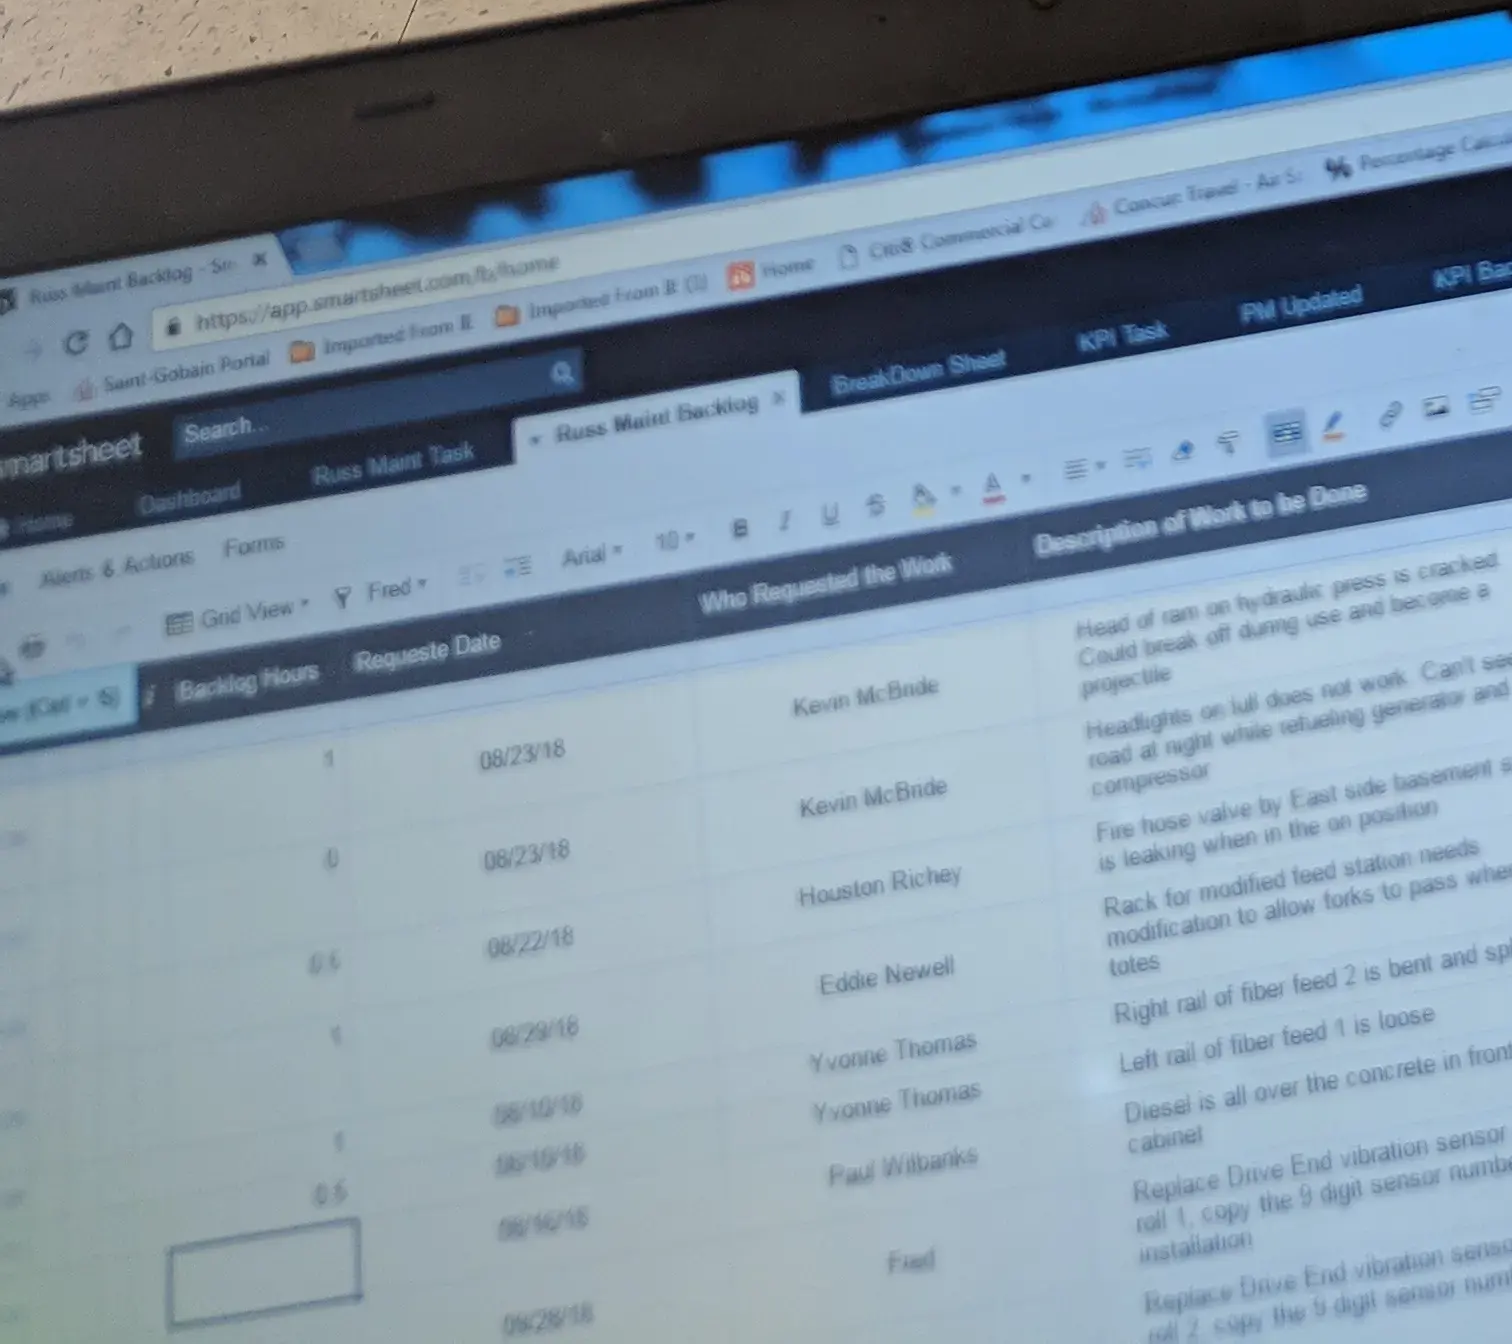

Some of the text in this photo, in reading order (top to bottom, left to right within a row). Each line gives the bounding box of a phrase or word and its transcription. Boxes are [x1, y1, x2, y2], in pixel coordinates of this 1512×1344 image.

[654, 529, 679, 551] 10
[1033, 483, 1368, 558] Description of Work to be Done
[222, 536, 285, 558] Forms
[561, 542, 606, 567] Arial
[367, 576, 411, 601] Fred
[697, 551, 953, 614] Who Requested the Work
[199, 601, 294, 629] Grid View
[353, 632, 501, 672] Requeste Date
[174, 664, 320, 702] Backlog Hours
[792, 677, 939, 717] Kevin McBride
[479, 737, 566, 771] 08/23/18
[799, 778, 948, 818] Kevin McBride
[1091, 762, 1209, 797] compressor
[1095, 820, 1134, 843] Fire
[1140, 813, 1191, 835] hose
[1198, 802, 1252, 825] valve
[1257, 796, 1281, 818] by
[1289, 784, 1337, 811] East
[1343, 777, 1387, 800] side
[1392, 758, 1492, 792] basement
[1098, 799, 1439, 873] is leaking when in the on position
[798, 866, 962, 907] Houston Richey
[1103, 838, 1480, 918] Rack for modified feed station needs
[1106, 912, 1231, 948] modification
[1236, 907, 1257, 926] to
[1263, 898, 1315, 921] allow
[1322, 886, 1375, 910] forks
[1380, 882, 1402, 901] to
[1408, 873, 1458, 901] pass
[819, 954, 954, 996] Eddie Newell
[1108, 954, 1160, 977] totes
[1113, 998, 1169, 1026] Right
[1176, 989, 1206, 1014] rail
[1213, 983, 1233, 1008] of
[1240, 981, 1283, 1002] fiber
[1291, 967, 1337, 994] feed
[1343, 963, 1356, 986] 2
[1363, 965, 1381, 982] is
[1387, 953, 1433, 978] bent
[1440, 943, 1478, 970] and
[809, 1033, 978, 1073] Yvonne Thomas
[1119, 1007, 1436, 1074] Left rail of fiber feed 1 is loose
[813, 1082, 982, 1123] Yvonne Thomas
[1124, 1094, 1191, 1124] Diesel
[1198, 1094, 1216, 1112] is
[1223, 1084, 1247, 1107] all
[1253, 1080, 1298, 1102] over
[1305, 1073, 1339, 1095] the
[1345, 1057, 1436, 1087] concrete
[1442, 1053, 1461, 1071] in
[1127, 1124, 1203, 1154] cabinet
[1132, 1174, 1219, 1203] Replace
[1227, 1164, 1283, 1188] Drive
[1290, 1149, 1333, 1177] End
[1339, 1139, 1429, 1168] vibration
[1435, 1125, 1505, 1153] sensor
